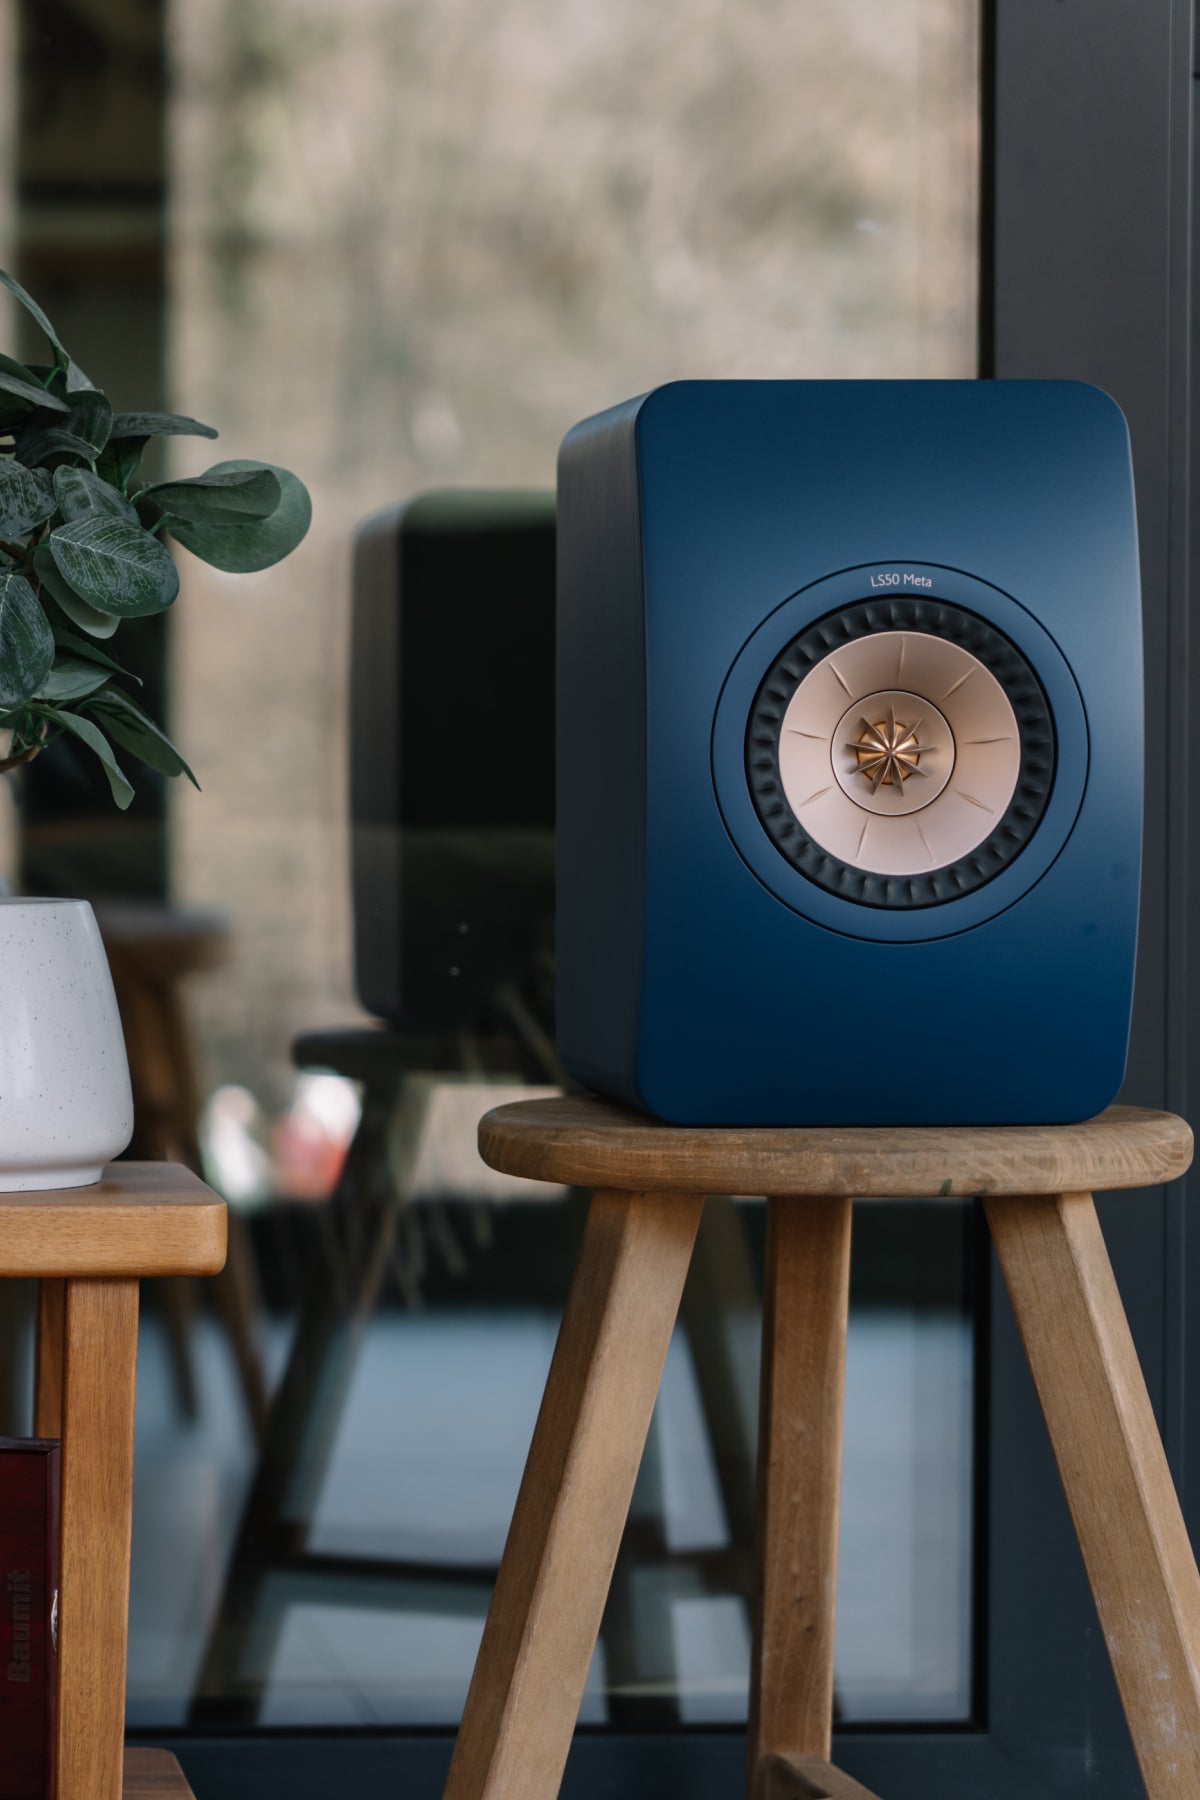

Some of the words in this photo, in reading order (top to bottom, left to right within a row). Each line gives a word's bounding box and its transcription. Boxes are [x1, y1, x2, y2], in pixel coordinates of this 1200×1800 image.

[870, 573, 900, 588] LS50
[903, 573, 933, 588] Meta
[7, 1569, 32, 1682] Baumit
